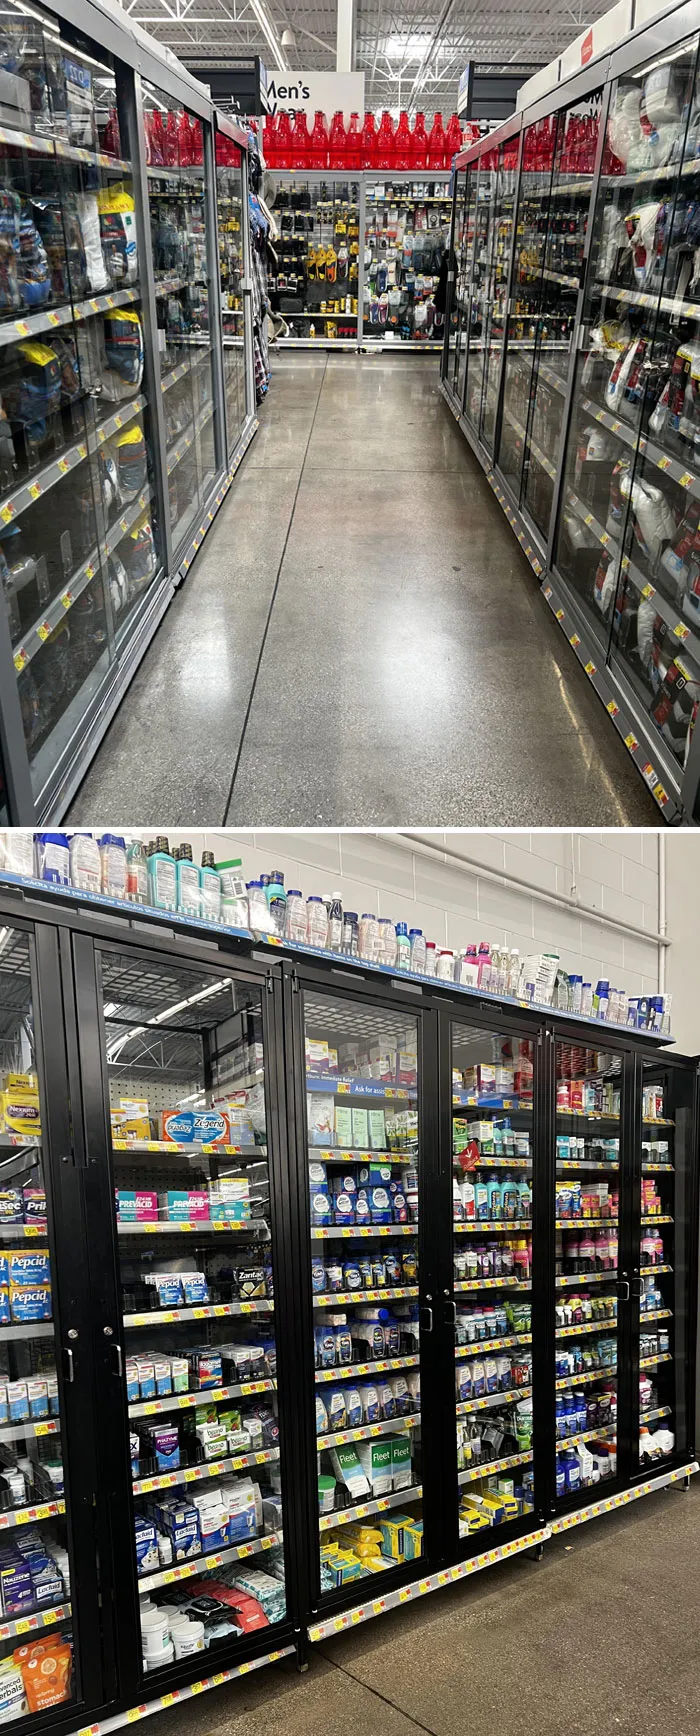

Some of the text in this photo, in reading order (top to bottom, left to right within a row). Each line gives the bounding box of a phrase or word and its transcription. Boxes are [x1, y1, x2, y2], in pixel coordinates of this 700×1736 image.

[194, 1116, 225, 1130] Zegerid
[11, 1255, 47, 1269] Pepcid
[12, 1290, 47, 1305] Pepcid
[339, 1452, 358, 1464] Fleet
[373, 1451, 391, 1462] Fleet
[393, 1447, 410, 1458] Fleet
[3, 1573, 31, 1584] Nauzene
[37, 1583, 61, 1595] Lactaid
